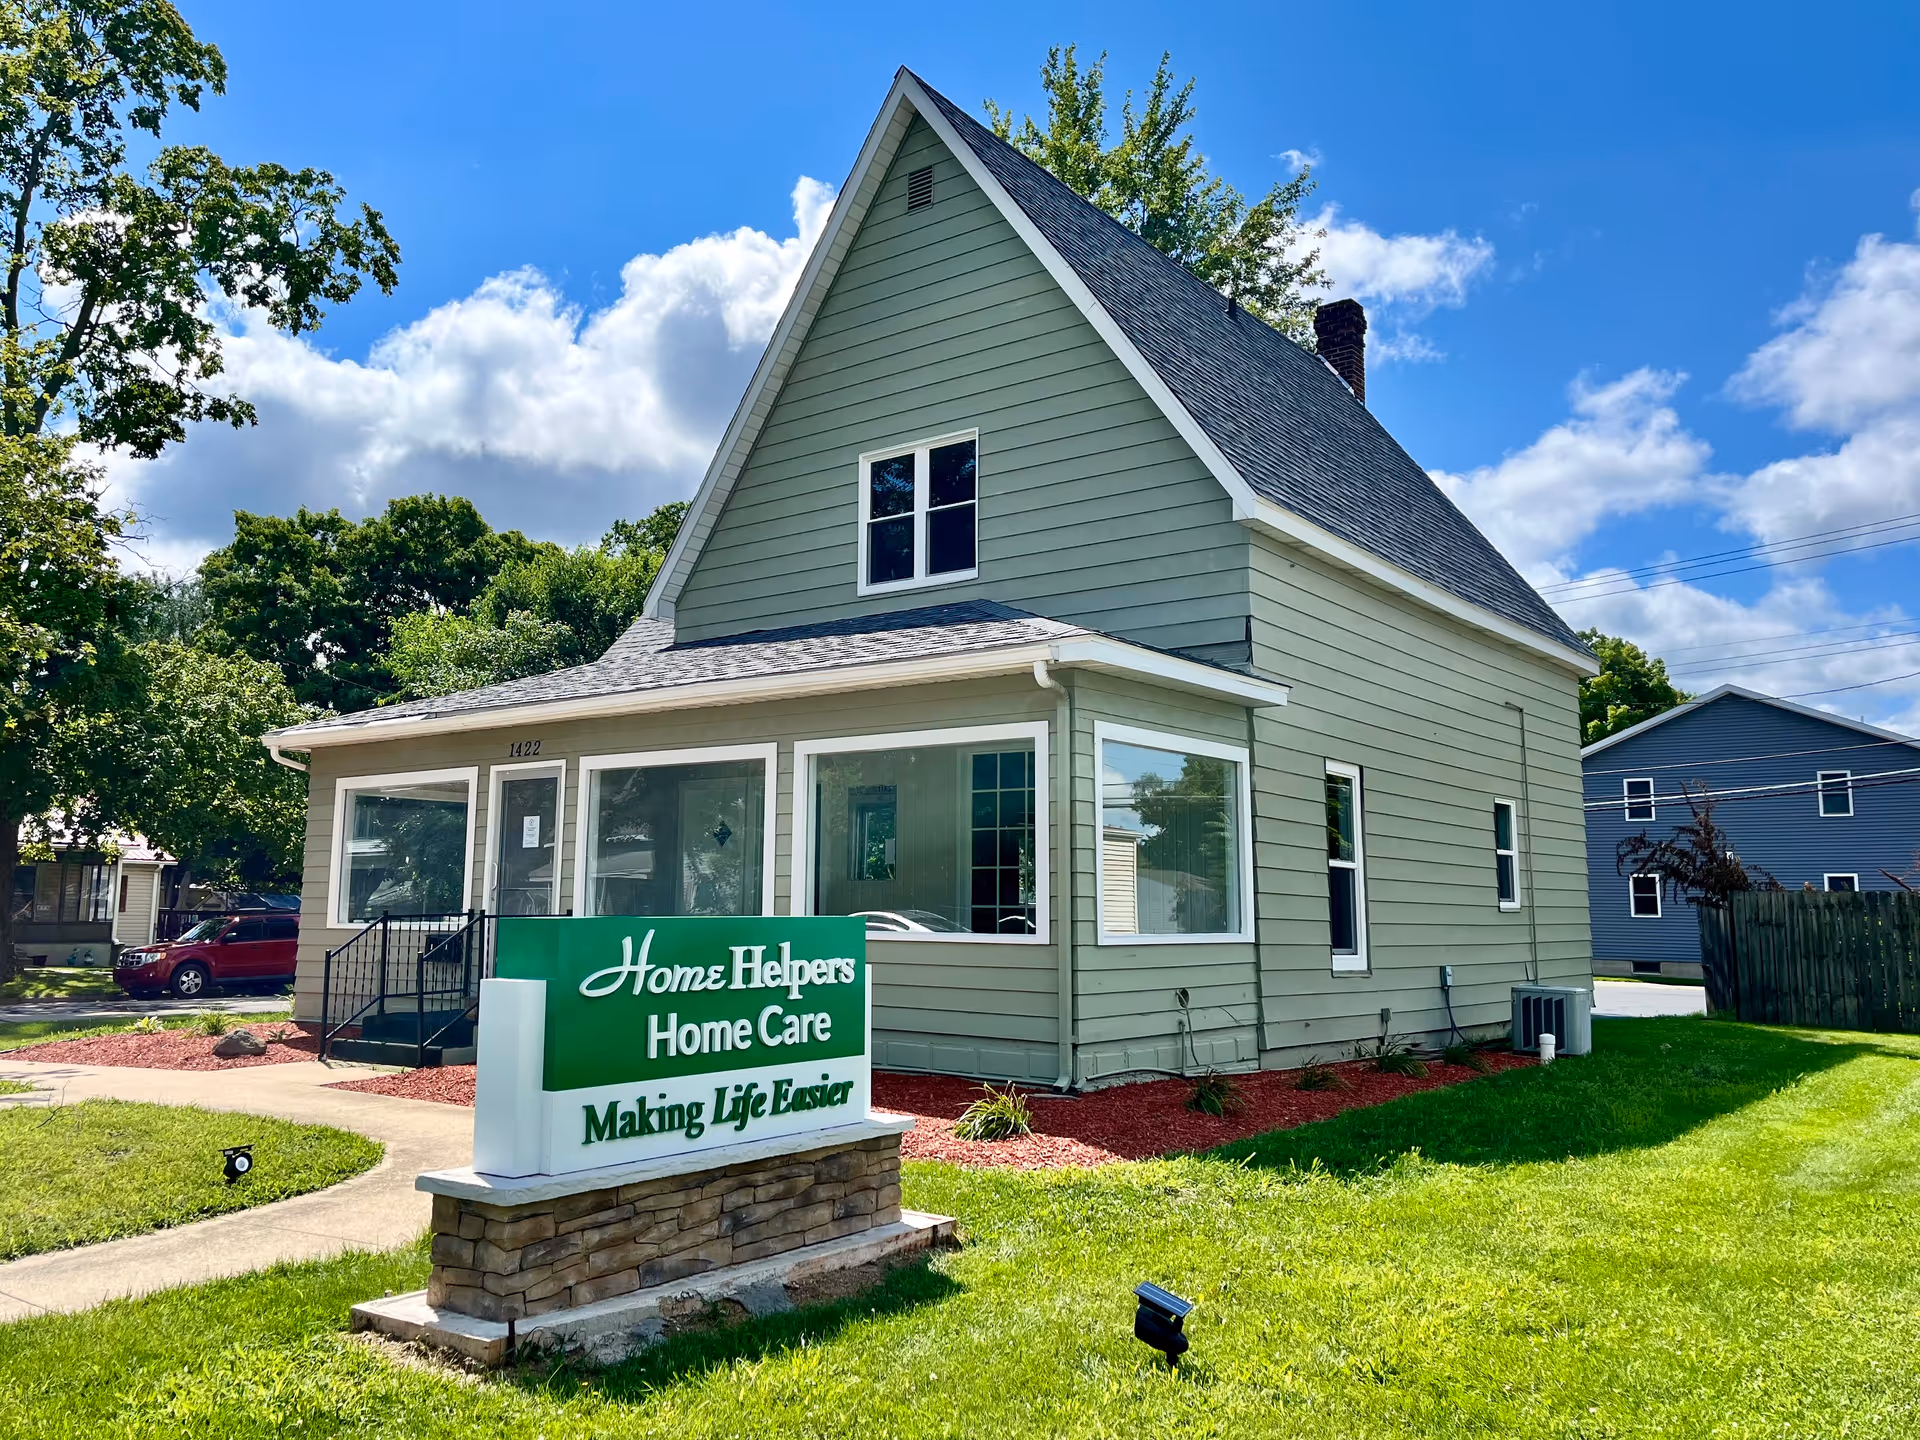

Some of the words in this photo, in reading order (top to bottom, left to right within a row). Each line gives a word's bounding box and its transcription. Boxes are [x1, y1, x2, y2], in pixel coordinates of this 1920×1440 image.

[509, 740, 541, 758] 1422
[579, 928, 726, 998] Home
[727, 941, 856, 1000] Helpers
[646, 1012, 752, 1059] Home
[757, 1004, 832, 1047] Care
[581, 1092, 705, 1145] Making
[711, 1081, 768, 1131] Life
[770, 1073, 854, 1116] Easier
